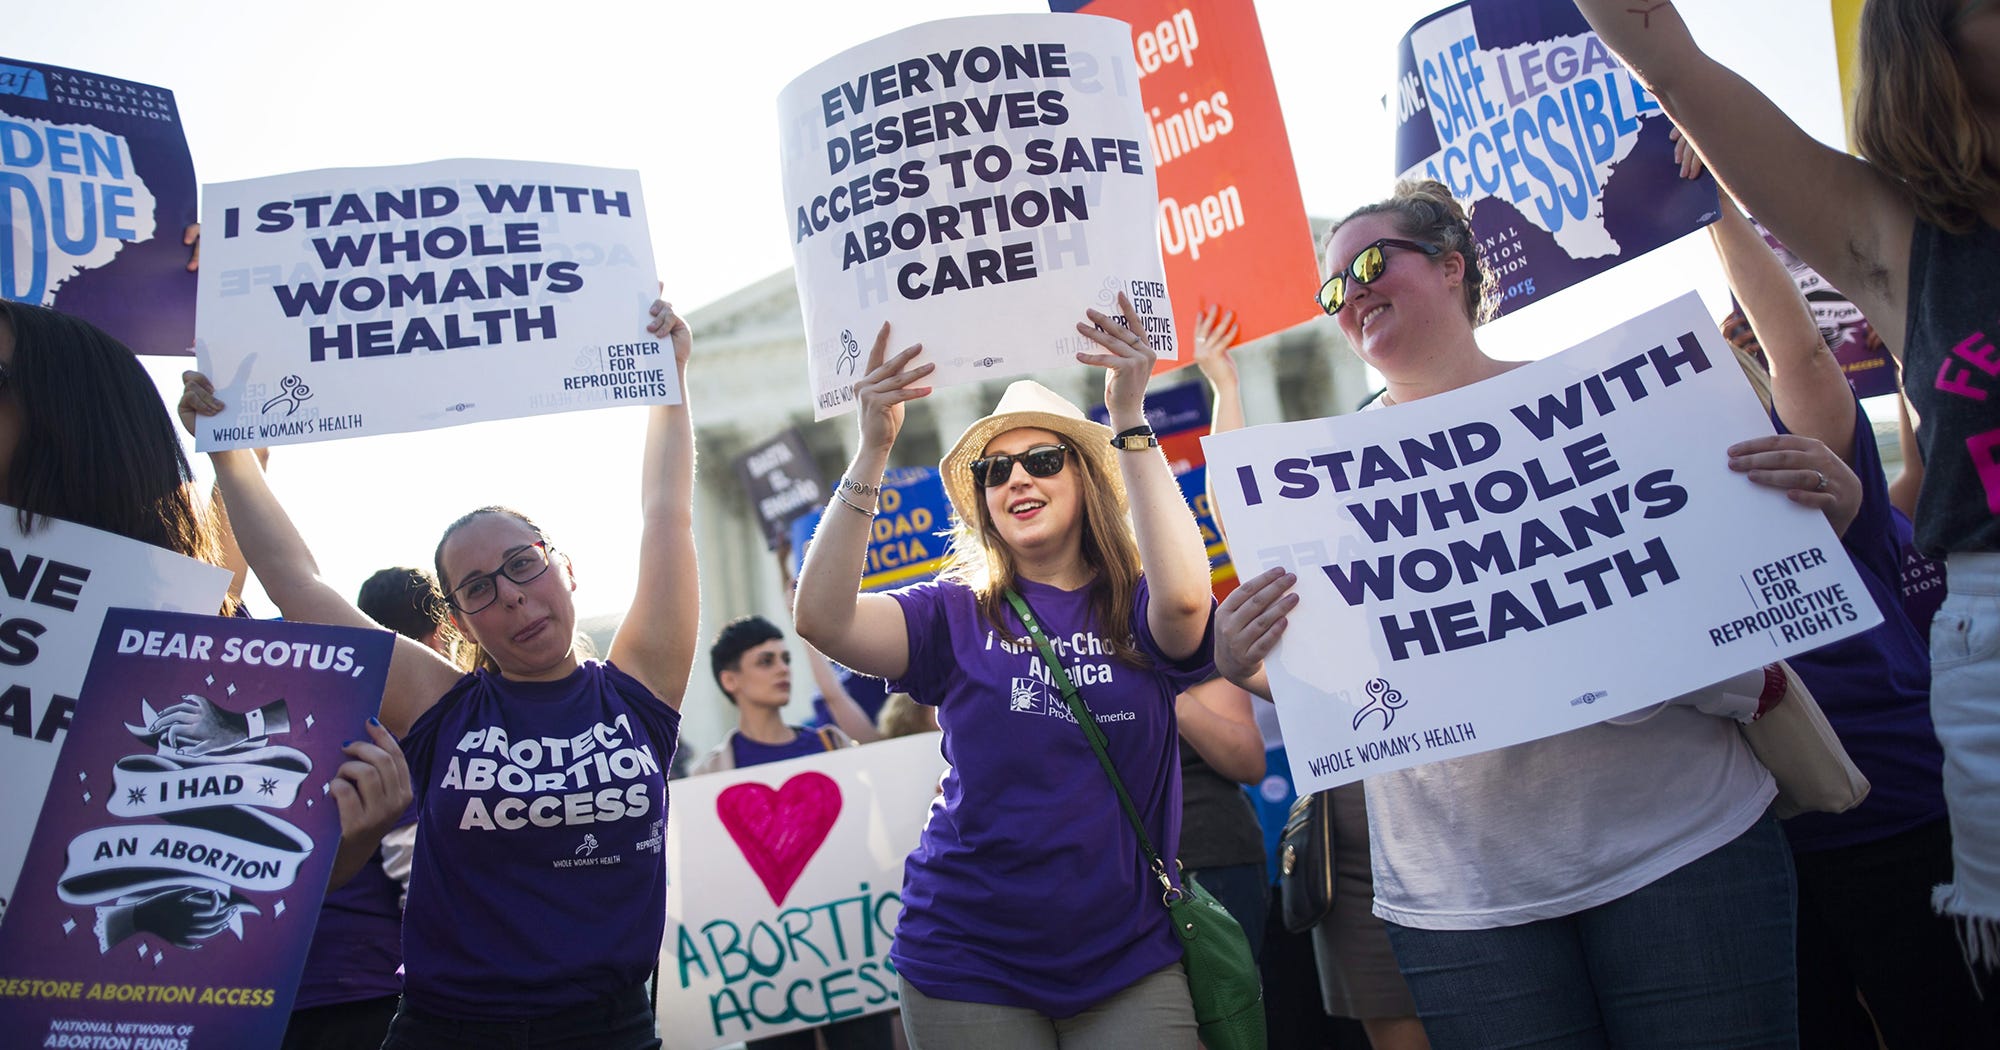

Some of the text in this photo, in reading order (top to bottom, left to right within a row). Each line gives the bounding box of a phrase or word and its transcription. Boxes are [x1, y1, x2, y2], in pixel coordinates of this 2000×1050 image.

[1136, 8, 1199, 79] eep
[51, 72, 165, 100] NATIONAL
[54, 85, 168, 111] ABORTION
[56, 95, 171, 122] FEDERATION
[821, 43, 1071, 128] EVERYONE
[1422, 34, 1504, 145] SAFE,
[826, 89, 1070, 176] DESERVES
[1145, 90, 1234, 167] linics
[1426, 71, 1660, 233] ACCESSIBLE
[224, 184, 631, 239] I STAND WITH
[796, 137, 1145, 244] ACCESS TO SAFE
[0, 170, 137, 306] DUE
[311, 222, 542, 270] WHOLE
[842, 185, 1089, 272] ABORTION
[1158, 185, 1245, 261] Open
[273, 261, 584, 318] WOMAN'S
[896, 241, 1038, 301] CARE
[1131, 280, 1165, 298] CENTER
[1133, 298, 1153, 314] FOR
[309, 305, 557, 363] HEALTH
[608, 342, 660, 358] CENTER
[564, 369, 664, 390] REPRODUCTIVE
[610, 358, 635, 371] FOR
[614, 383, 666, 399] RIGHTS
[213, 414, 362, 442] WHOLE WOMAN'S HEALTH
[1236, 330, 1713, 507] I STAND WITH
[1345, 432, 1621, 544] WHOLE
[1321, 468, 1689, 607] WOMAN'S
[1752, 547, 1828, 586] CENTER
[1379, 536, 1681, 662] HEALTH
[1708, 583, 1848, 647] REPRODUCTIVE
[1760, 578, 1802, 605] FOR
[1780, 602, 1858, 643] RIGHTS
[117, 629, 365, 678] DEAR SCOTUS,
[440, 744, 660, 793] ABORTION
[1308, 722, 1477, 778] WHOLE WOMAN'S HEALTH
[160, 775, 244, 802] I HAD
[459, 783, 650, 831] ACCESS
[93, 838, 282, 880] AN ABORTION
[553, 860, 572, 868] WHOLE
[600, 855, 621, 865] HEALTH
[0, 979, 275, 1006] RESTORE ABORTION ACCESS
[43, 1034, 189, 1050] ABORTION FUNDS
[50, 1020, 195, 1036] NATIONAL NETWORK OF
